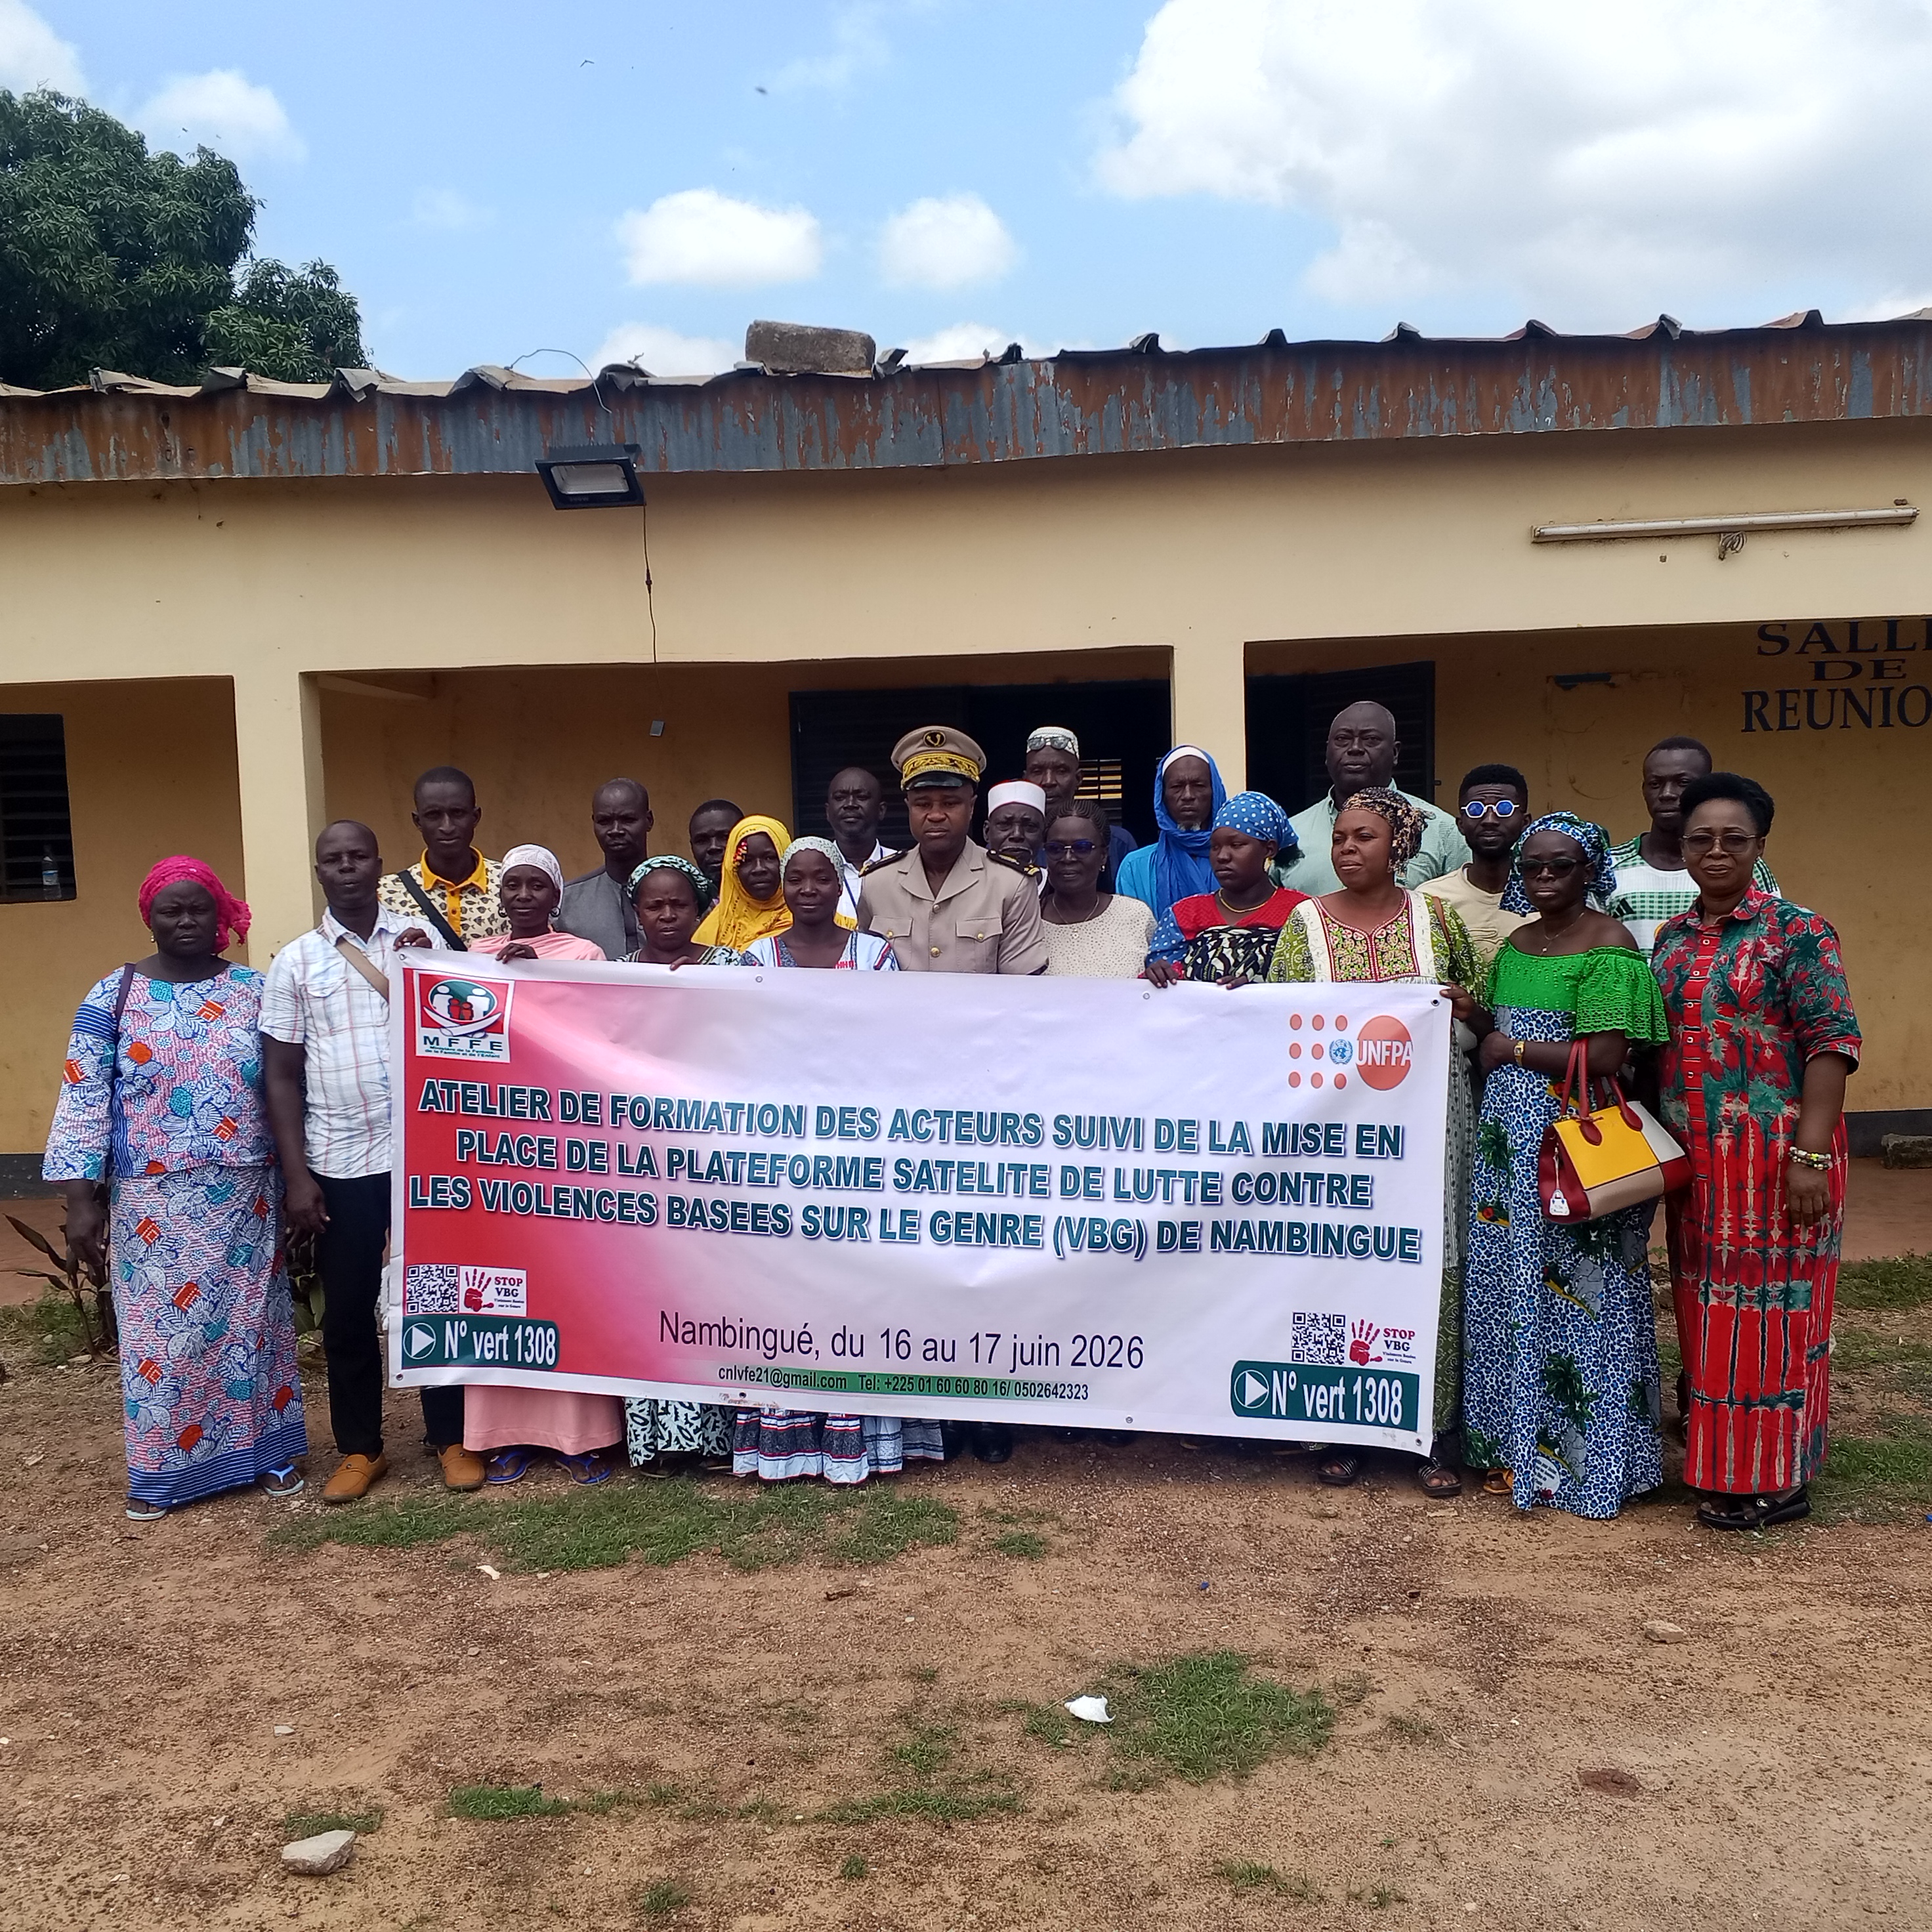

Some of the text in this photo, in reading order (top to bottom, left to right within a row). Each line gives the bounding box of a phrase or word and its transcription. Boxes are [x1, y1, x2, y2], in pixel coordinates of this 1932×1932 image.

[1808, 658, 1906, 681] DE
[1741, 685, 1932, 733] REUNIO
[1356, 1040, 1413, 1066] UNFPA
[419, 1079, 1404, 1158] ATELIER DE FORMATION DES ACTEURS SUIVI DE LA MISE EN
[456, 1129, 1373, 1208] PLACE DE LA PLATEFORME SATELITE DE LUTTE CONTRE
[409, 1175, 1421, 1263] LES VIOLENCES BASEES SUR LE GENRE (VBG) DE NAMBINGUE
[494, 1276, 523, 1287] STOP
[495, 1288, 519, 1297] VBG
[472, 1324, 509, 1362] vert
[514, 1324, 556, 1366] 1308
[660, 1311, 1144, 1374] Nambingué, du 16 au 17 juin 2026
[1383, 1328, 1416, 1340] STOP
[1384, 1339, 1410, 1352] VBG
[718, 1365, 847, 1389] cnlvfe21@gmail.com
[858, 1374, 880, 1391] Tel:
[884, 1376, 914, 1392] +225
[918, 1377, 932, 1393] 01
[936, 1377, 951, 1394] 60
[955, 1379, 970, 1395] 60
[973, 1379, 988, 1395] 80
[1014, 1381, 1089, 1400] 0502642323
[1303, 1376, 1345, 1420] vert
[1353, 1376, 1403, 1425] 1308
